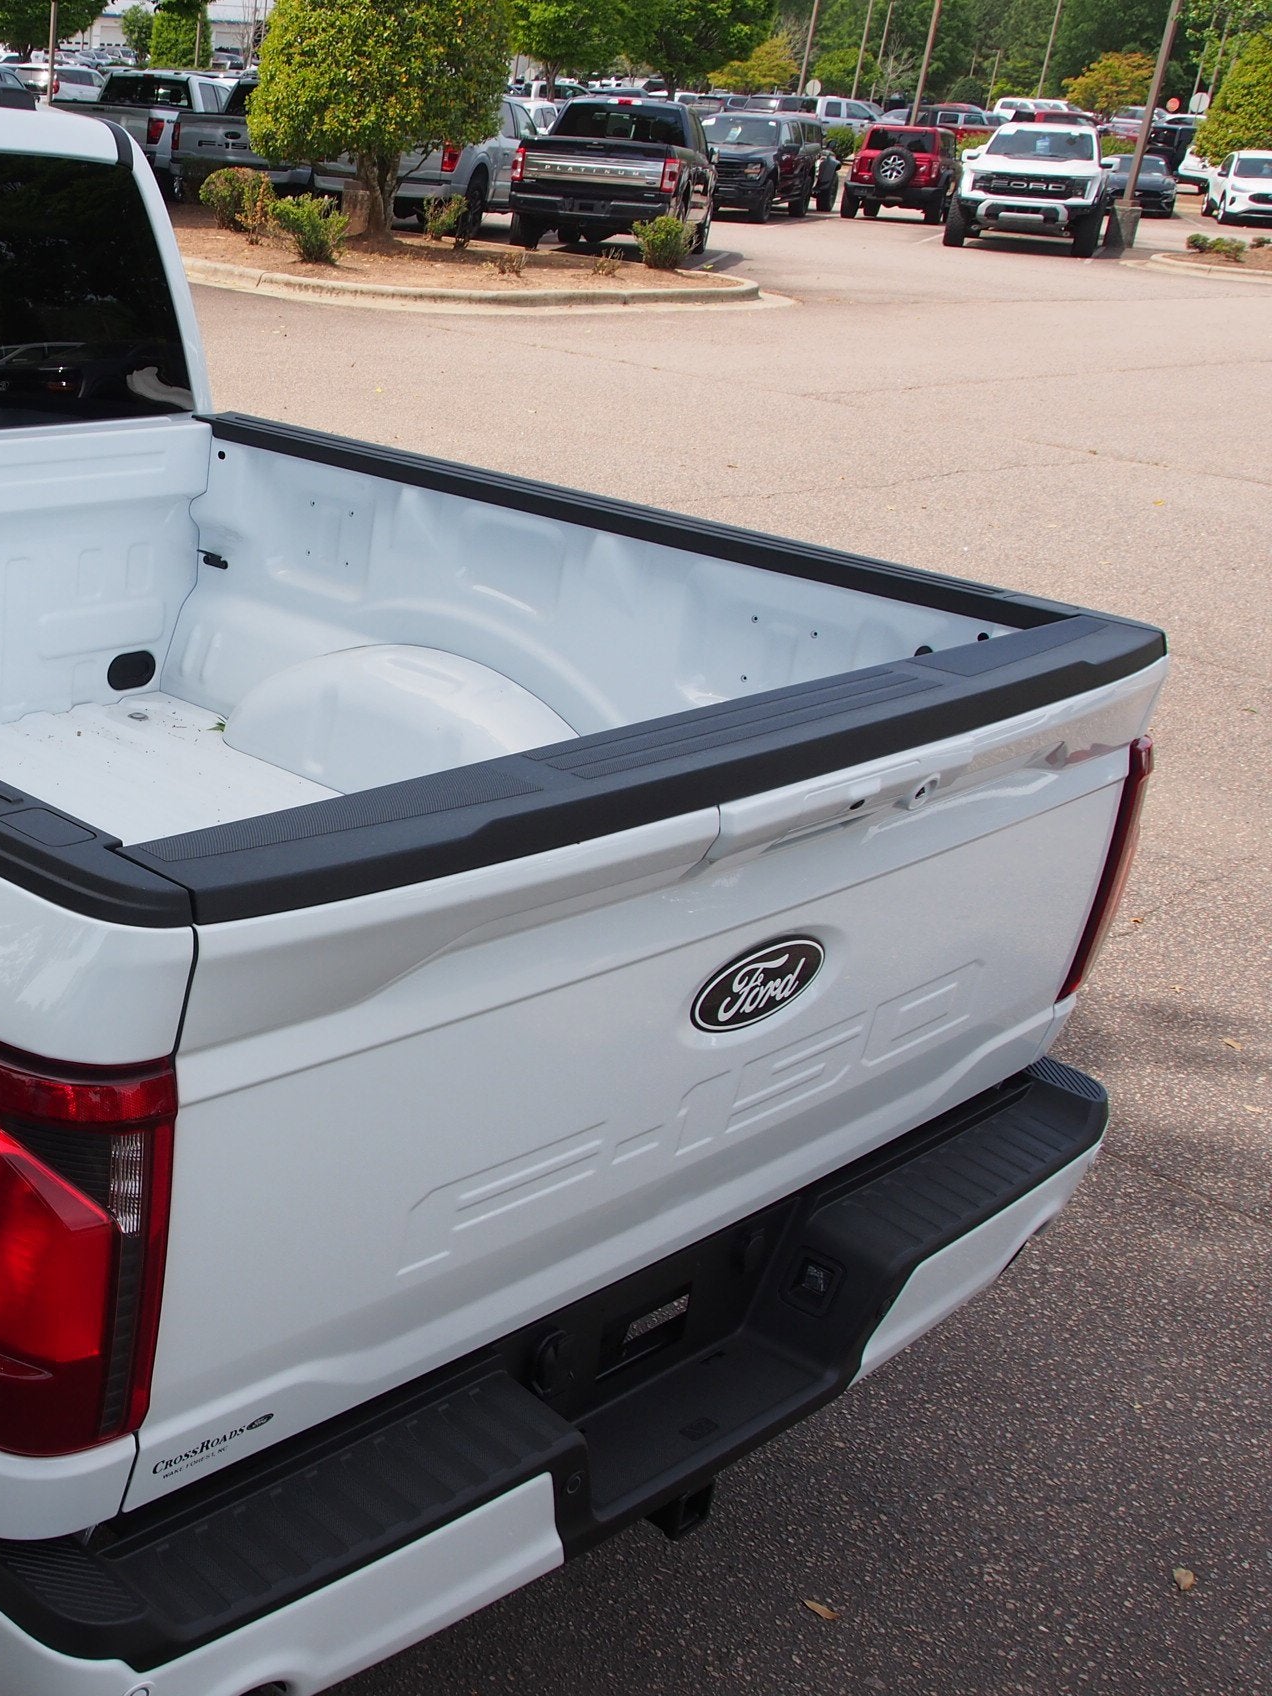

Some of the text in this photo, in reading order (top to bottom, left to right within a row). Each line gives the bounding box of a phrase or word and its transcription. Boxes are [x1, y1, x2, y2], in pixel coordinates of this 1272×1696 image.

[544, 164, 640, 176] PLATINUM
[991, 179, 1066, 191] FORD
[717, 953, 806, 1022] Ford
